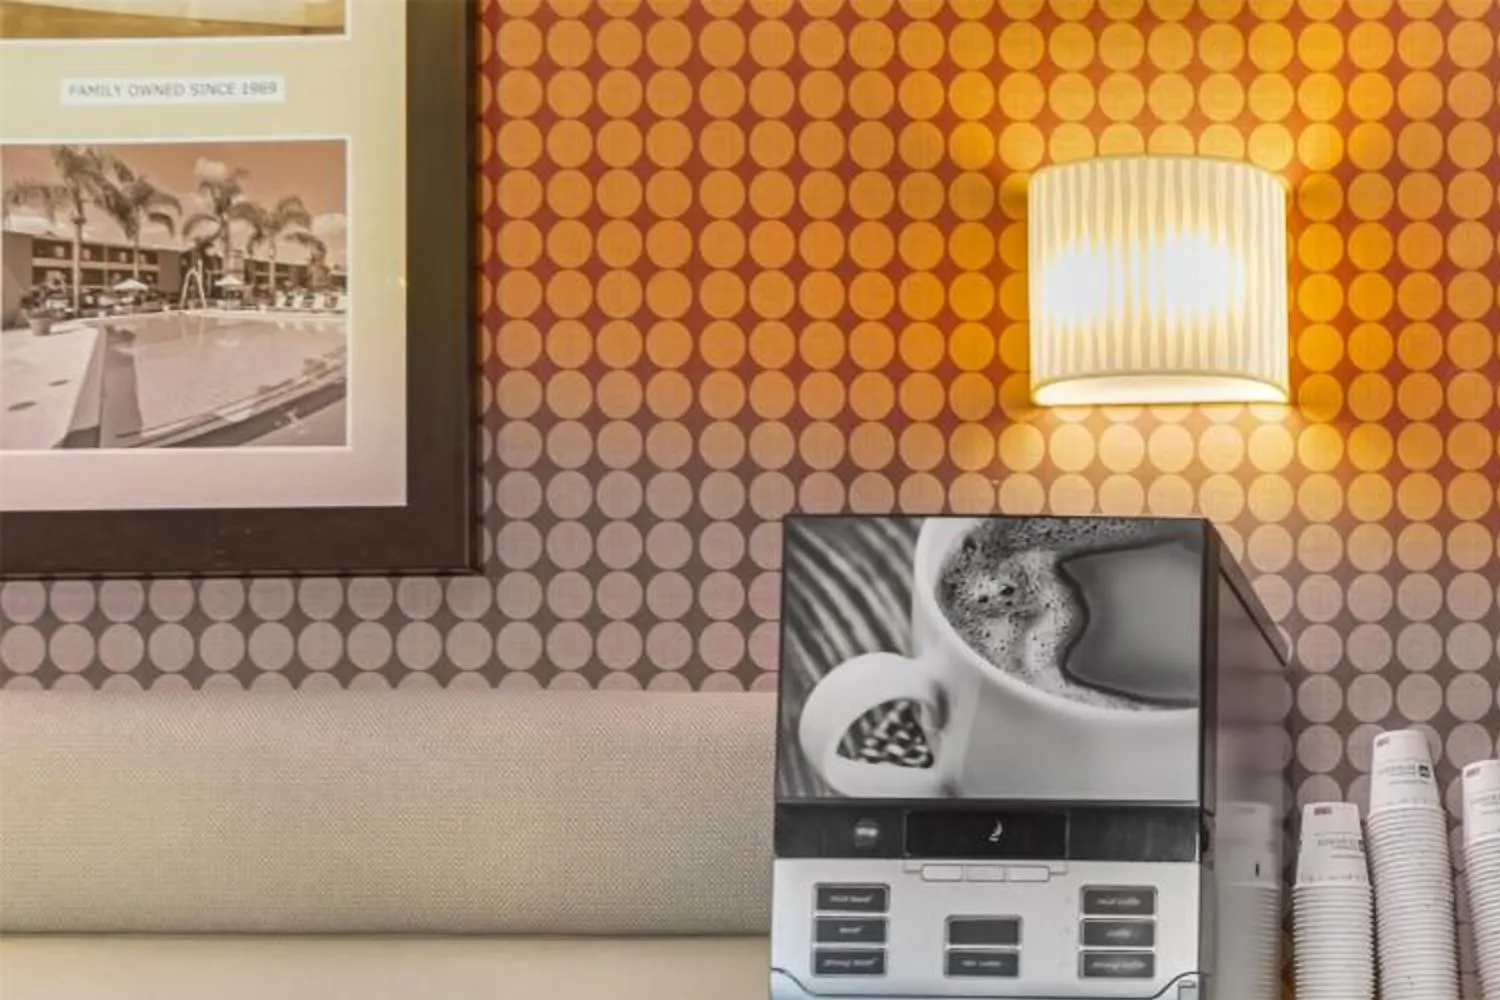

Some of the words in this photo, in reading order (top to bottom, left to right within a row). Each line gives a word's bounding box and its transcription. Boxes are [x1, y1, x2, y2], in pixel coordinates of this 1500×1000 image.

[68, 83, 122, 98] FAMILY
[128, 82, 185, 98] OWNED
[190, 81, 236, 97] SINCE
